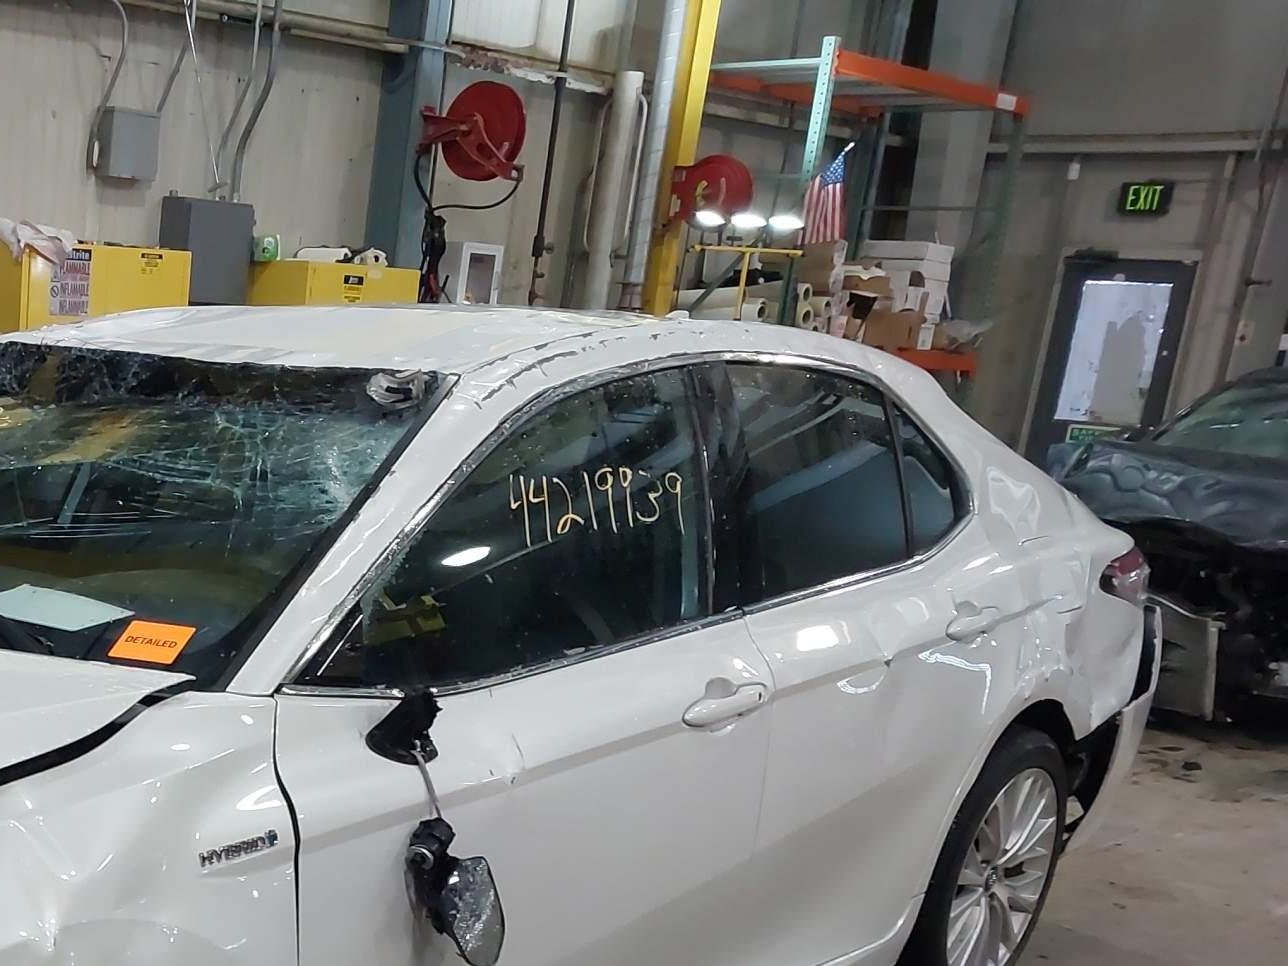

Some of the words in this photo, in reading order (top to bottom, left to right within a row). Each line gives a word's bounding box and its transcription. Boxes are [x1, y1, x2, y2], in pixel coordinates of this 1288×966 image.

[1126, 185, 1165, 210] EXIT
[509, 466, 685, 548] 44219939
[124, 635, 178, 649] DETAILED
[198, 835, 266, 868] HYBRID
